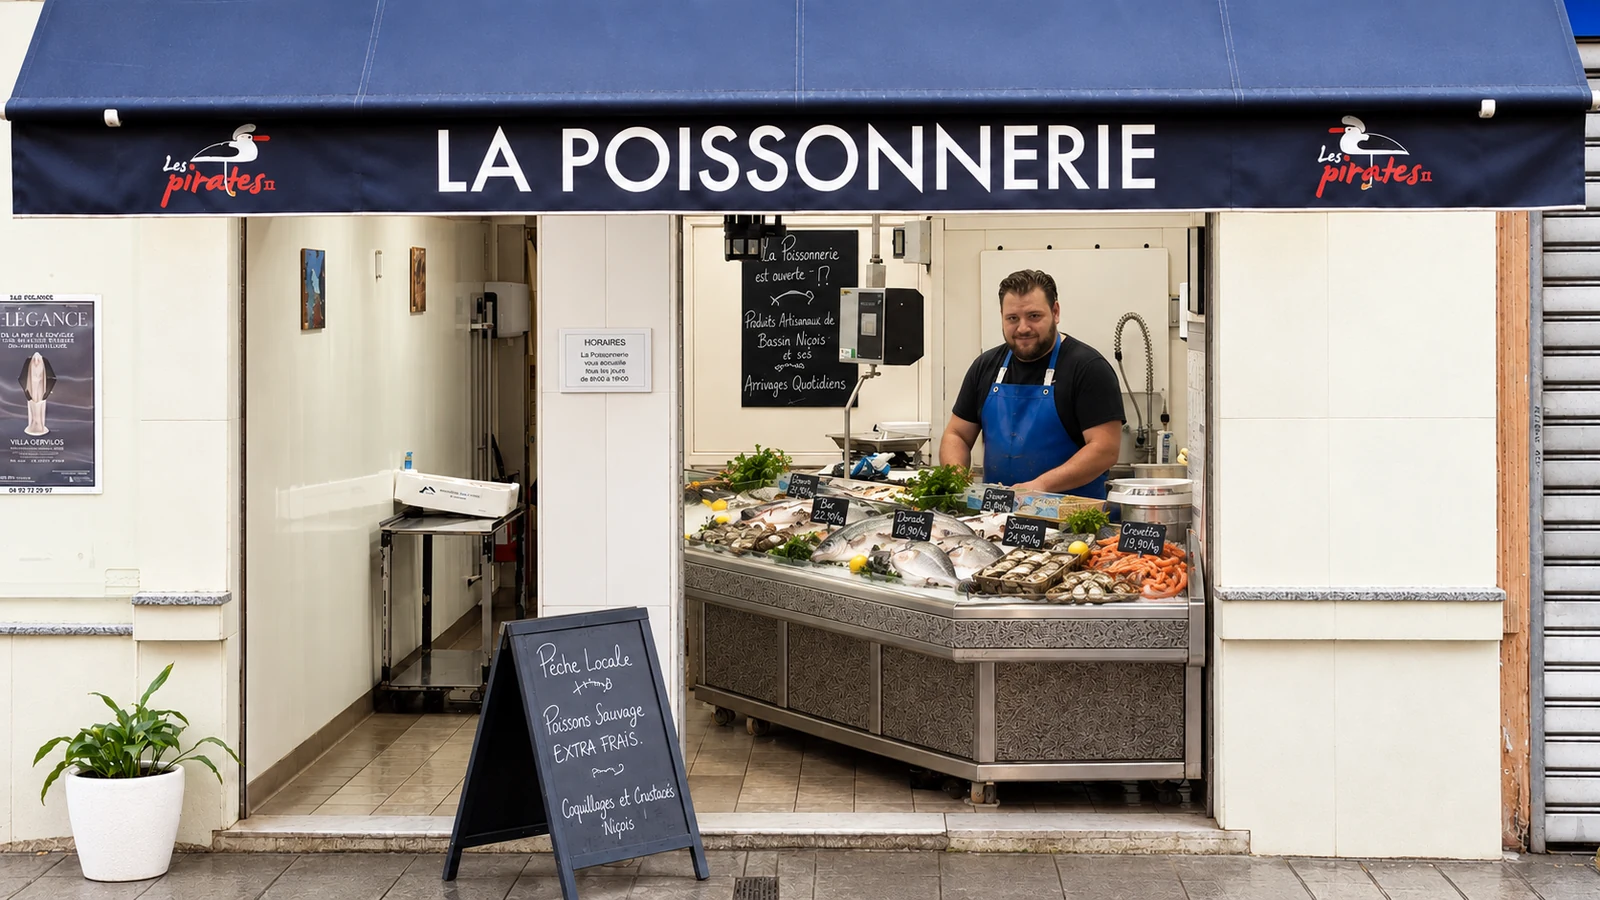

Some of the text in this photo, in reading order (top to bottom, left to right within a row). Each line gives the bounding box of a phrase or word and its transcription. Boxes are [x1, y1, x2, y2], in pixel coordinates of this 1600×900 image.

[162, 154, 187, 173] Les
[437, 122, 1155, 193] LA POISSONNERIE
[1317, 144, 1342, 163] Les
[160, 163, 266, 208] pirates
[1315, 154, 1422, 199] pirates
[761, 234, 840, 262] La Poissonnerie
[755, 268, 770, 283] est
[772, 266, 806, 281] ouverte
[778, 312, 821, 327] Artisanaux
[823, 311, 836, 325] de
[757, 332, 791, 348] Bassin
[783, 349, 812, 360] et ses
[744, 374, 846, 398] Arrivages Quotidiens
[896, 511, 925, 524] Dorade
[584, 644, 633, 672] Locale
[543, 702, 645, 735] Poissons Sauvage
[553, 739, 597, 763] EXTRA
[561, 783, 675, 824] Coquillages et Crustacés
[603, 816, 635, 840] Niçois
